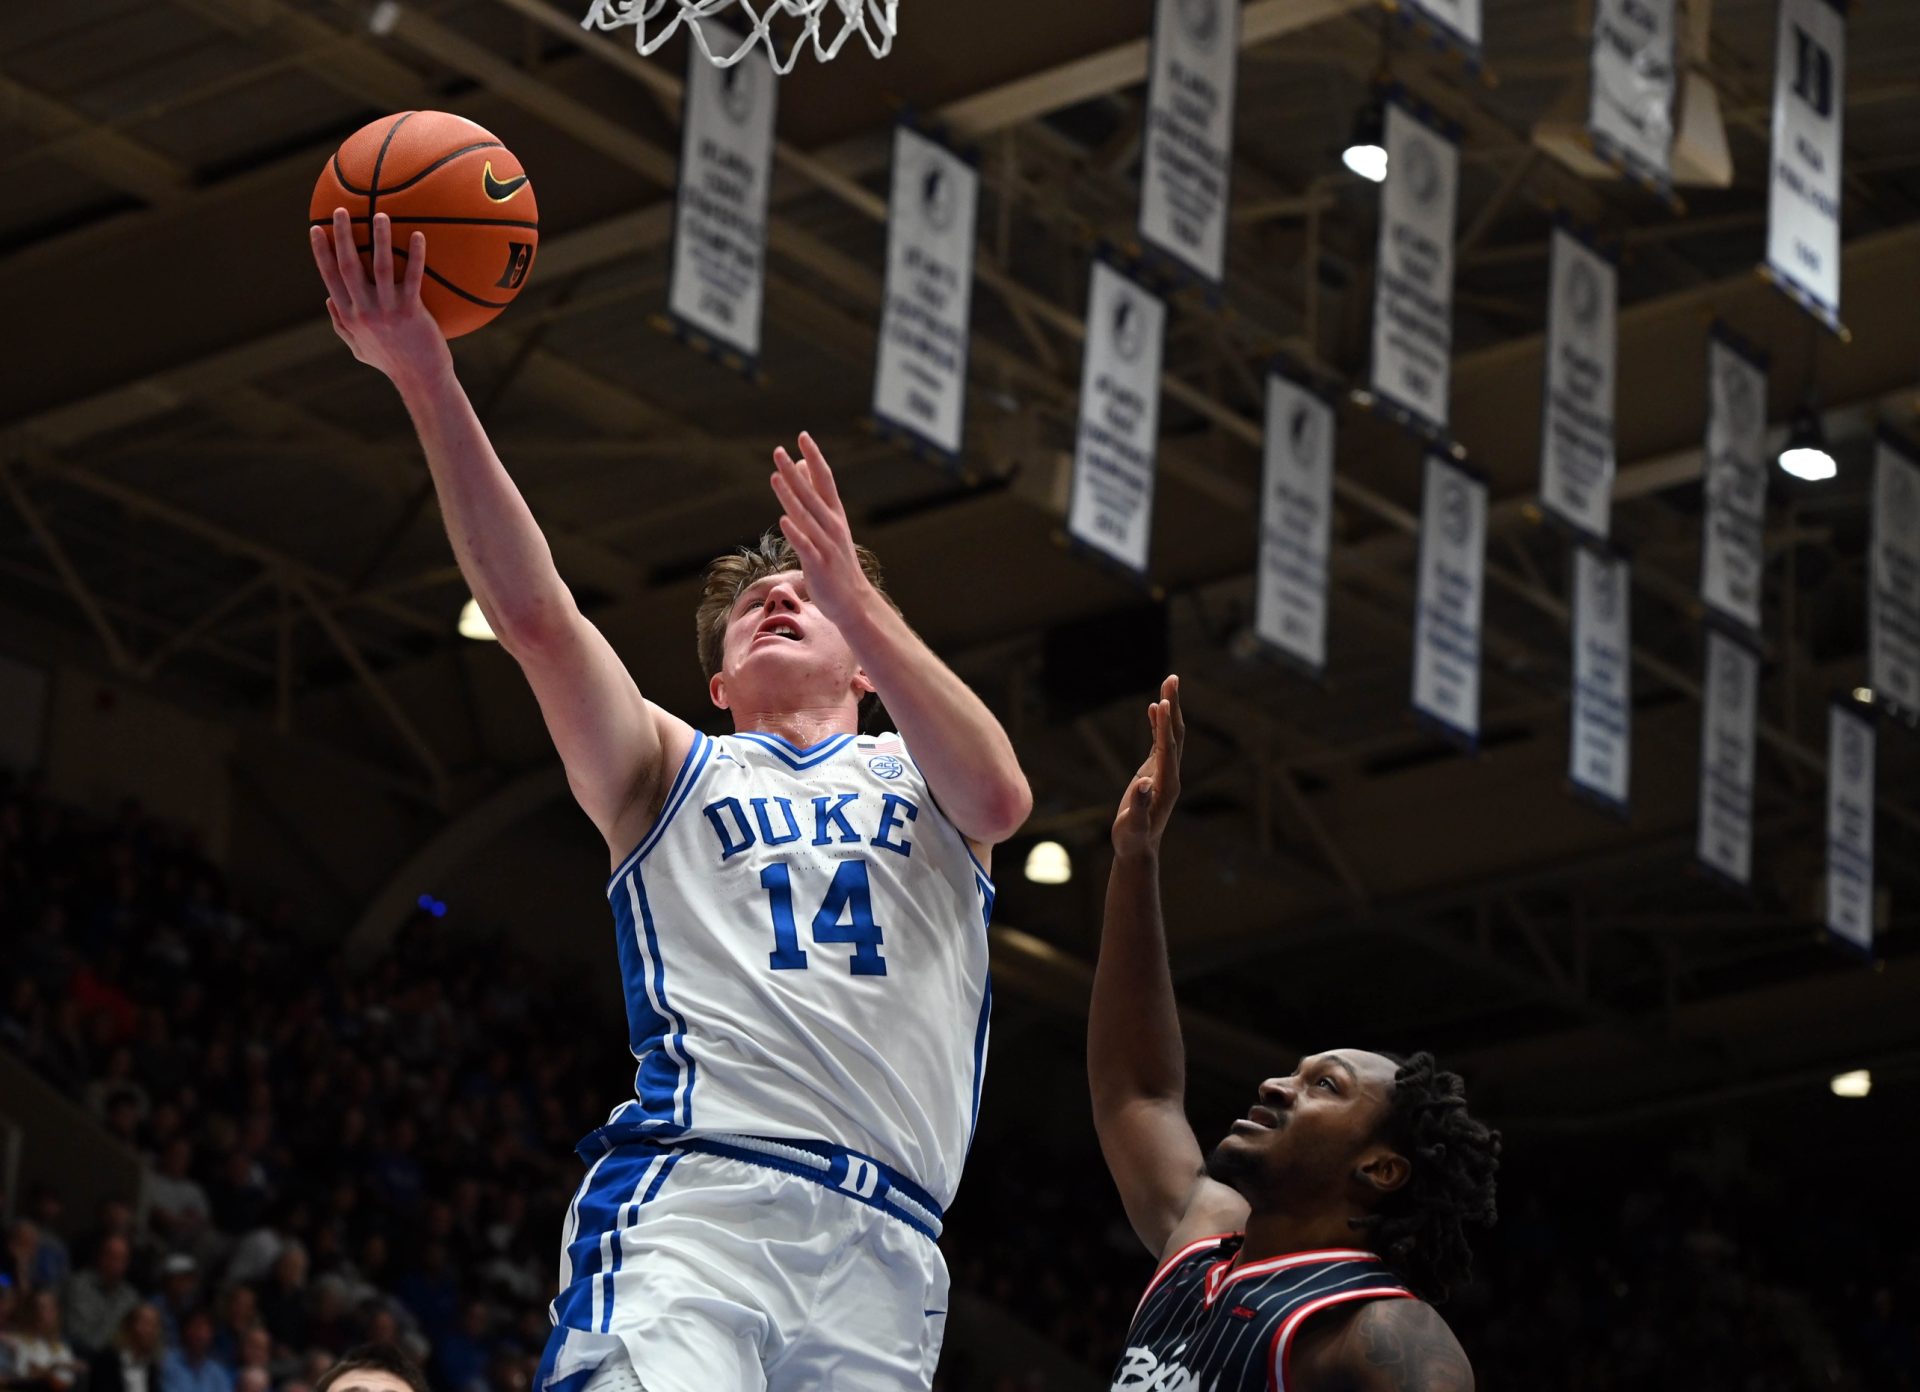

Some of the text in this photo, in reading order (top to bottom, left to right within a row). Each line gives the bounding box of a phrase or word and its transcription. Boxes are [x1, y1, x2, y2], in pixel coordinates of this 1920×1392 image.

[873, 761, 899, 770] ACC
[703, 793, 918, 861] DUKE
[760, 860, 887, 976] 14
[839, 1154, 878, 1198] D
